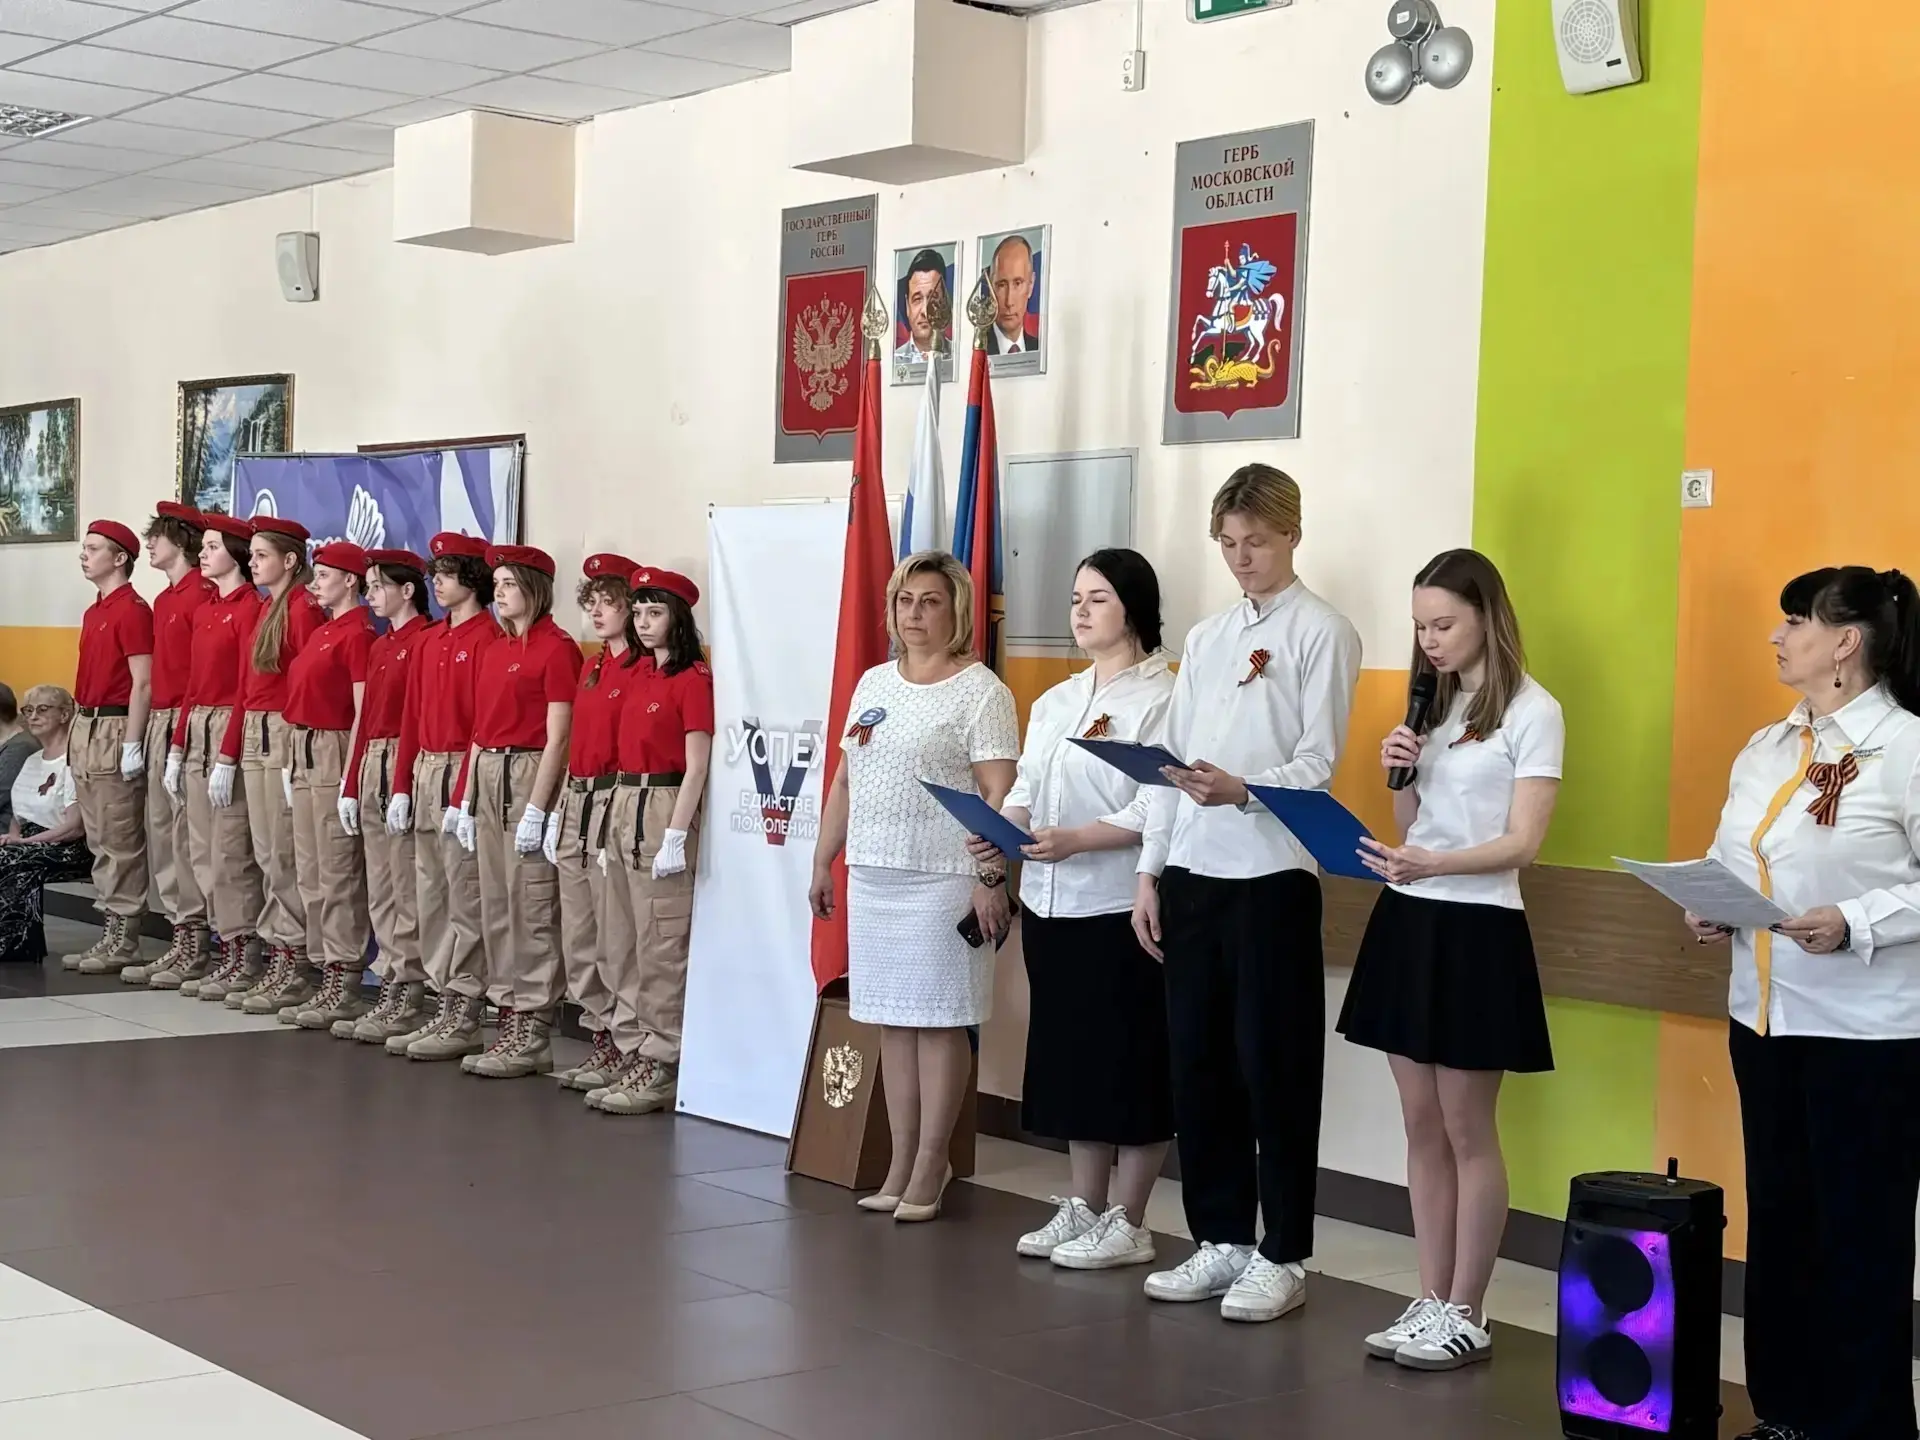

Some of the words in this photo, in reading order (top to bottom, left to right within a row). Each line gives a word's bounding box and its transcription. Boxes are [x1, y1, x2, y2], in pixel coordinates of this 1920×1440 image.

[1223, 144, 1260, 164] ГЕРБ
[1190, 157, 1296, 191] МОСКОВСКОЙ
[1205, 186, 1275, 210] ОБЛАСТИ
[785, 206, 872, 233] ГОСУДАРСТВЕННЫЙ
[816, 229, 838, 243] ГЕРБ
[810, 244, 845, 259] РОССИИ
[740, 791, 813, 814] ЕДИНСТВЕ
[731, 814, 819, 839] ПОКОЛЕНИЙ
